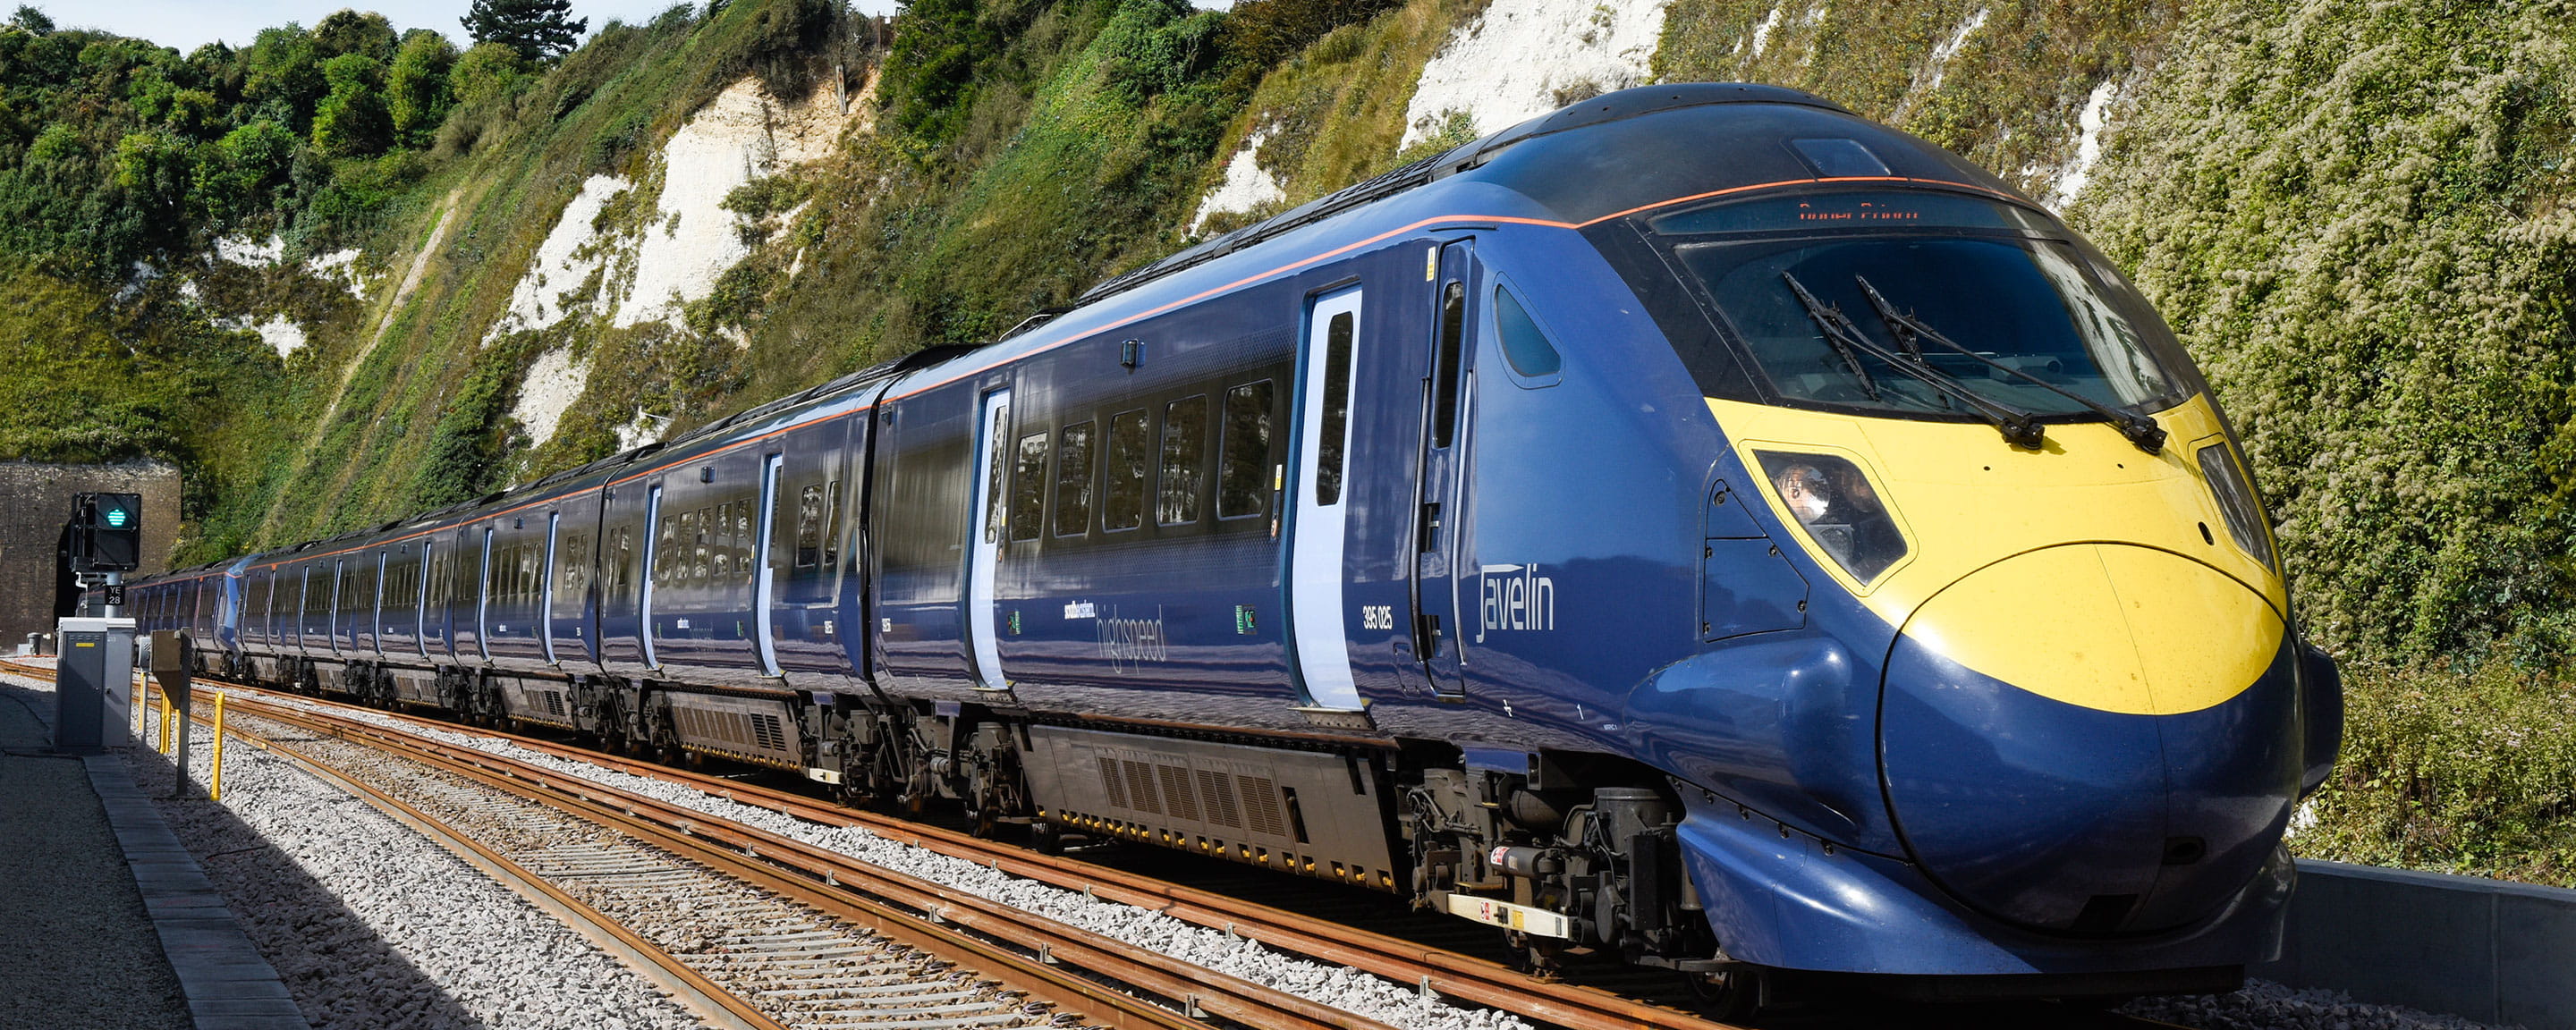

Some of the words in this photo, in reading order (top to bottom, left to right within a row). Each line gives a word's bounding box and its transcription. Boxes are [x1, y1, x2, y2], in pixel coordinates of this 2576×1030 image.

[108, 595, 121, 604] 28
[109, 586, 122, 595] YE
[1475, 563, 1554, 644] Javelin
[1362, 605, 1377, 629] 395
[1377, 605, 1393, 629] 025
[1096, 604, 1167, 675] highspeed
